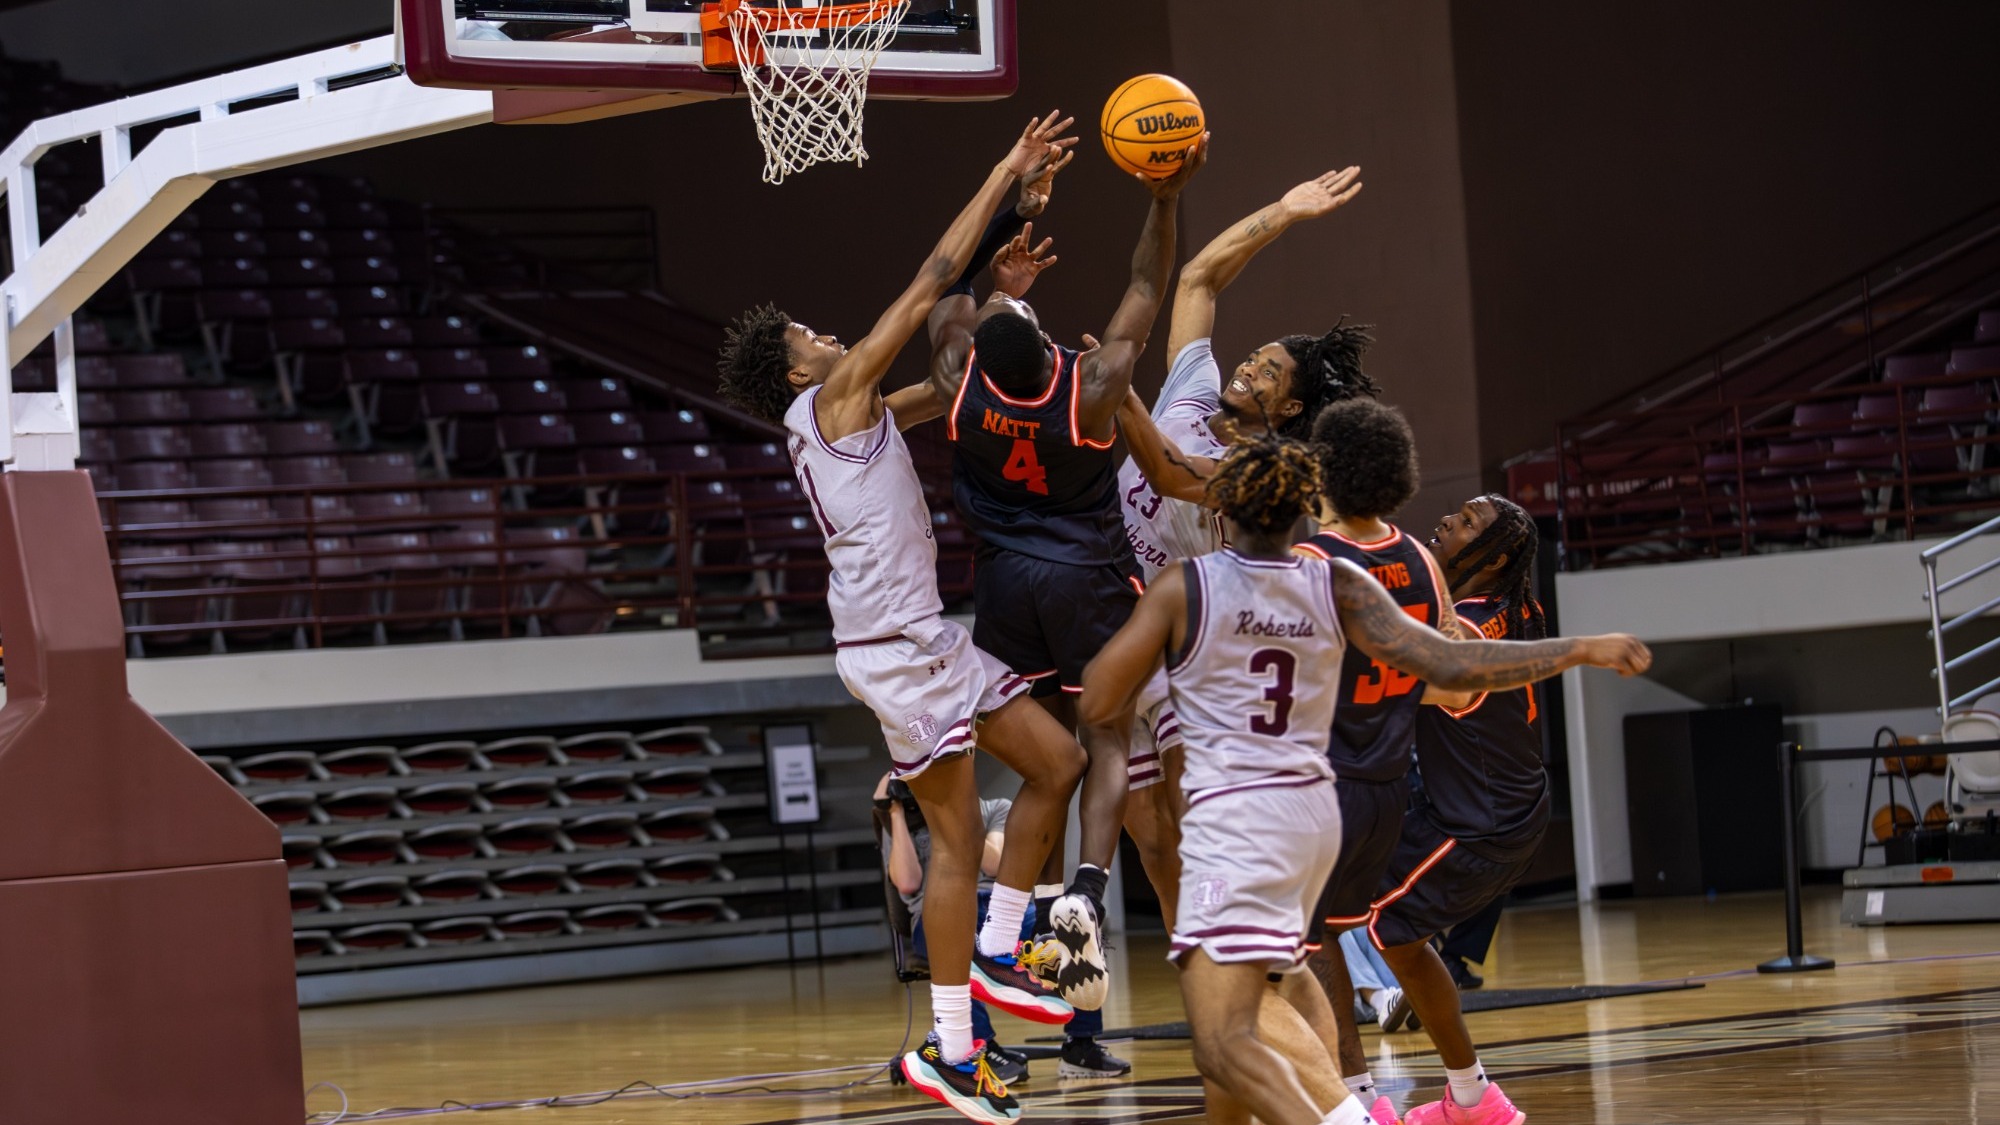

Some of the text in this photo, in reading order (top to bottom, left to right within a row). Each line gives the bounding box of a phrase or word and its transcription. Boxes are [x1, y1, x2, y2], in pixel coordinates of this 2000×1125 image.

[1135, 112, 1199, 135] Wilson
[1148, 147, 1190, 163] NCA
[982, 407, 1041, 439] NATT
[1002, 438, 1049, 496] 4
[1234, 610, 1316, 638] Roberts
[1249, 648, 1297, 738] 3
